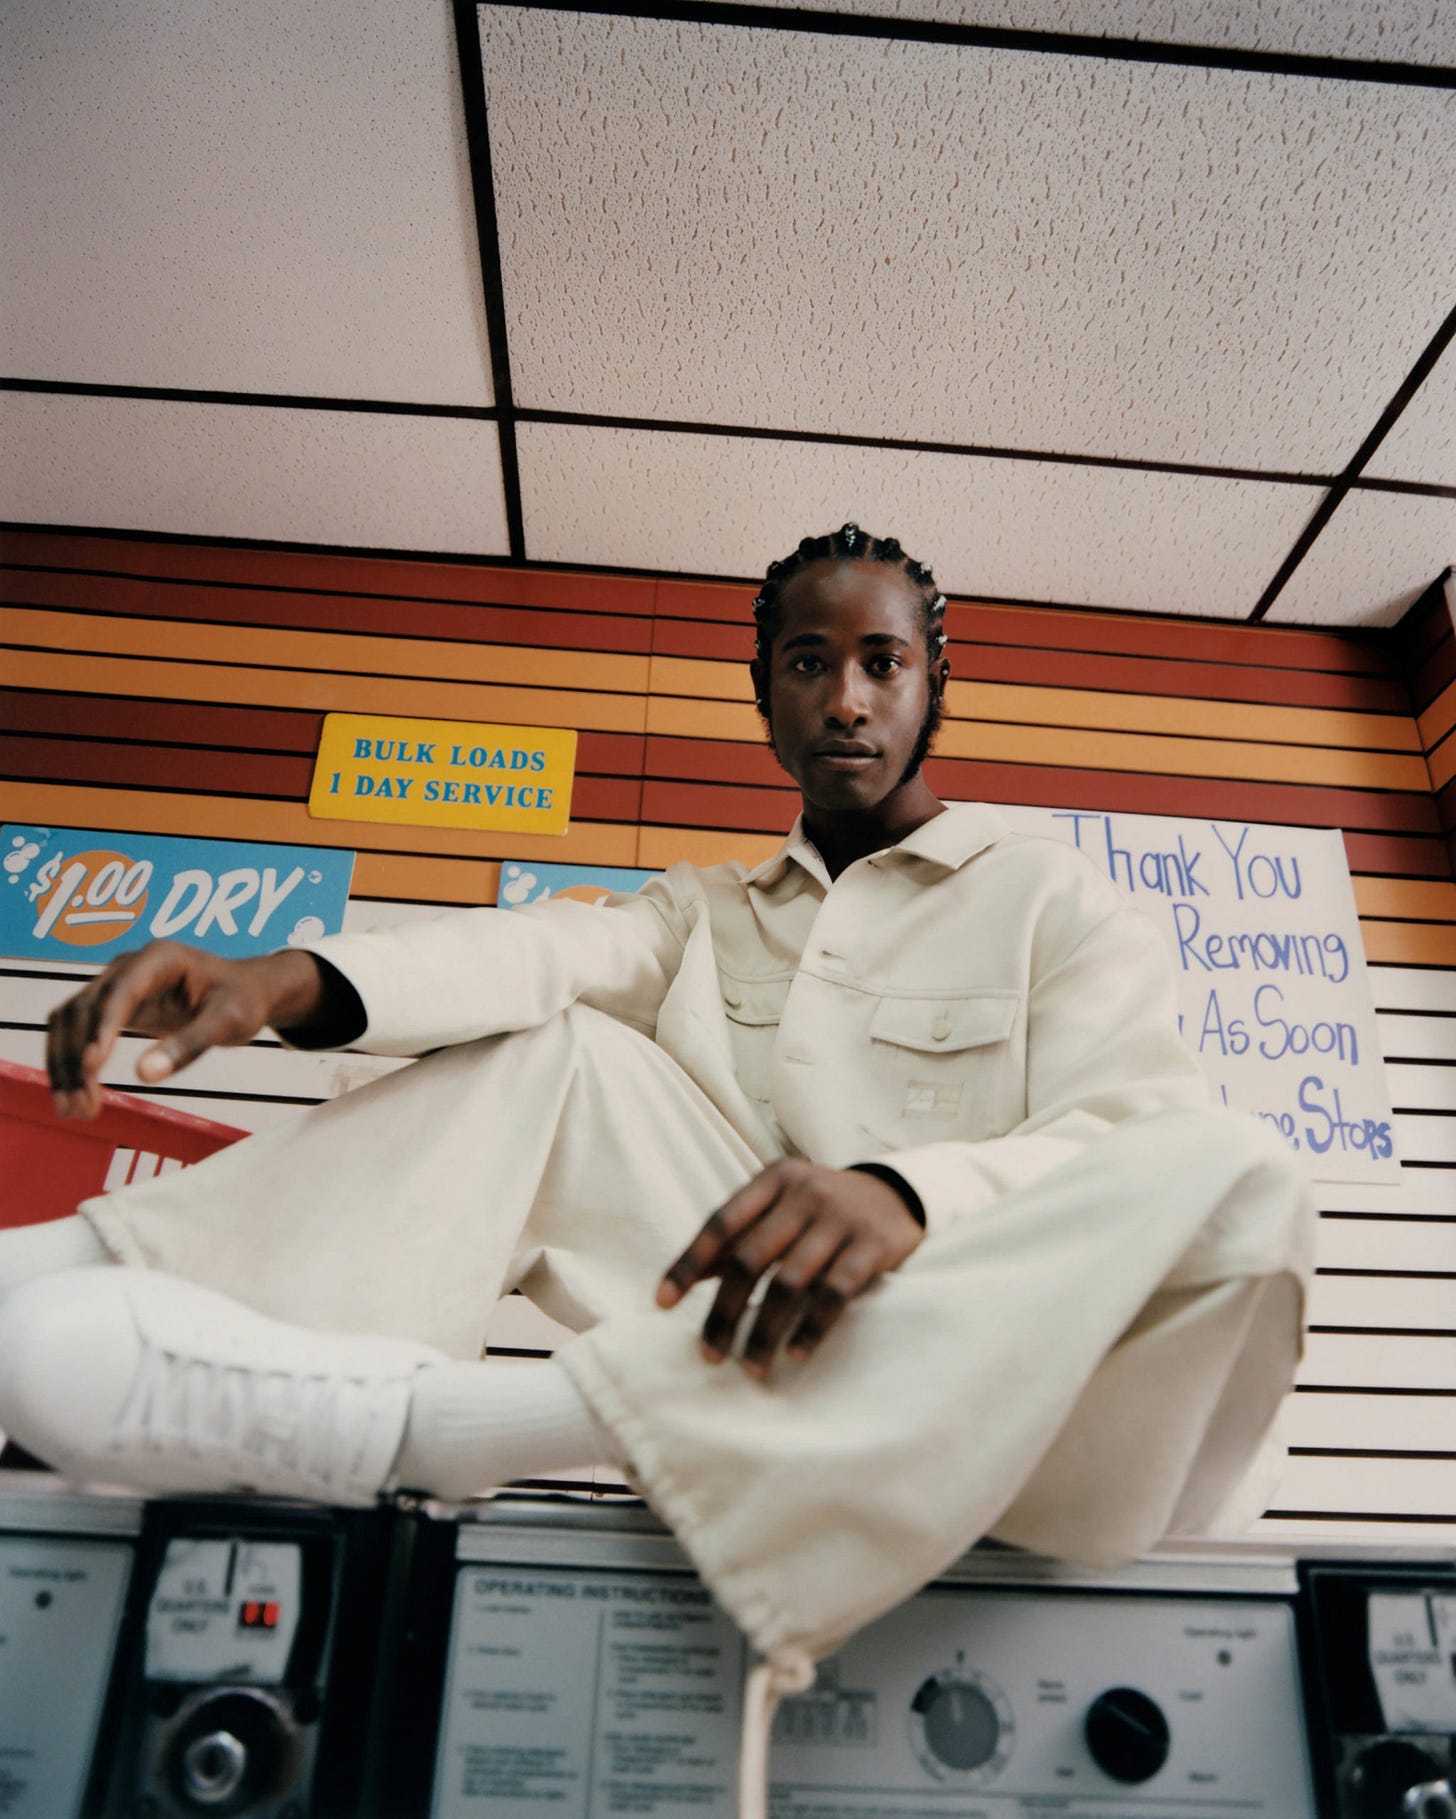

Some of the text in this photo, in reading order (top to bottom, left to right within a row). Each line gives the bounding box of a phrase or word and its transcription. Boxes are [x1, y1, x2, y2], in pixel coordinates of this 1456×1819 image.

[329, 772, 554, 809] 1 DAY SERVICE
[353, 738, 546, 771] BULK LOADS
[28, 851, 306, 940] $1.00 DRY
[1053, 813, 1210, 897] Thank
[1173, 903, 1350, 984] Removing
[1199, 984, 1360, 1066] As Soon
[1298, 1075, 1393, 1161] Stops
[475, 1580, 576, 1600] OPERATING
